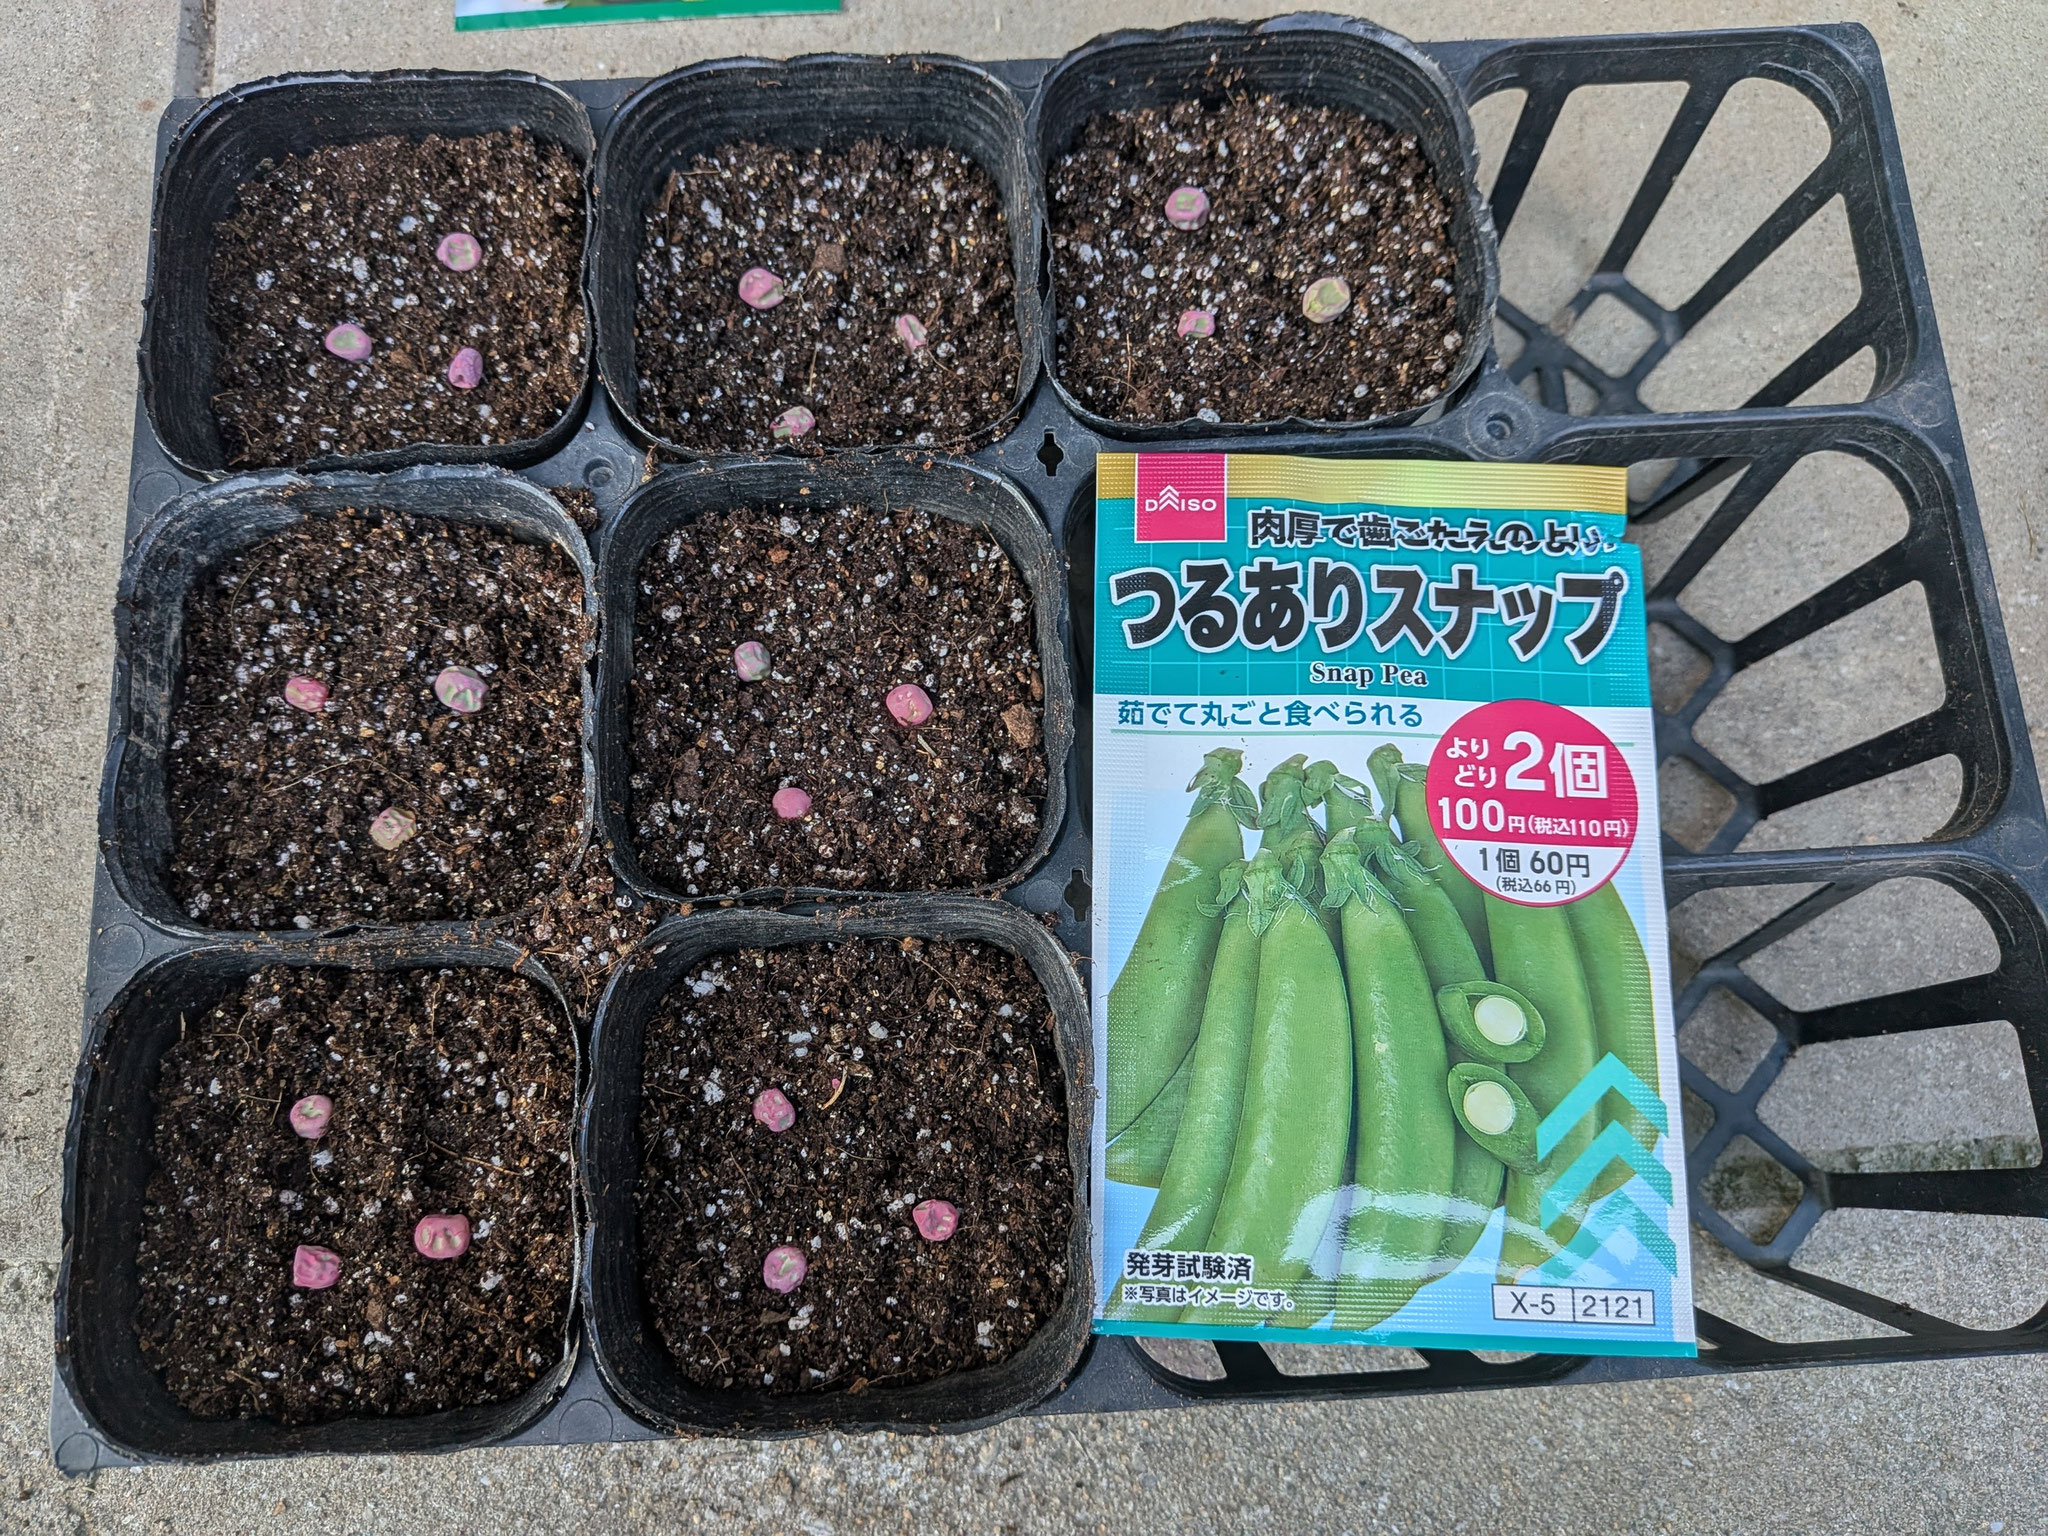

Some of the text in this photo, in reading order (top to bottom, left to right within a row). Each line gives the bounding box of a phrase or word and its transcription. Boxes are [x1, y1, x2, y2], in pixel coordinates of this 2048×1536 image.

[1145, 485, 1217, 511] DAISO
[1111, 559, 1627, 663] つるありスナップ
[1312, 662, 1428, 687] Snap Pea
[1118, 700, 1422, 728] 茹でて丸ごと食べられる
[1446, 737, 1489, 760] より
[1454, 765, 1497, 788] どり
[1503, 731, 1608, 799] 2個
[1126, 1252, 1252, 1281] 発芽試験済
[1510, 1291, 1642, 1318] X-5 2121
